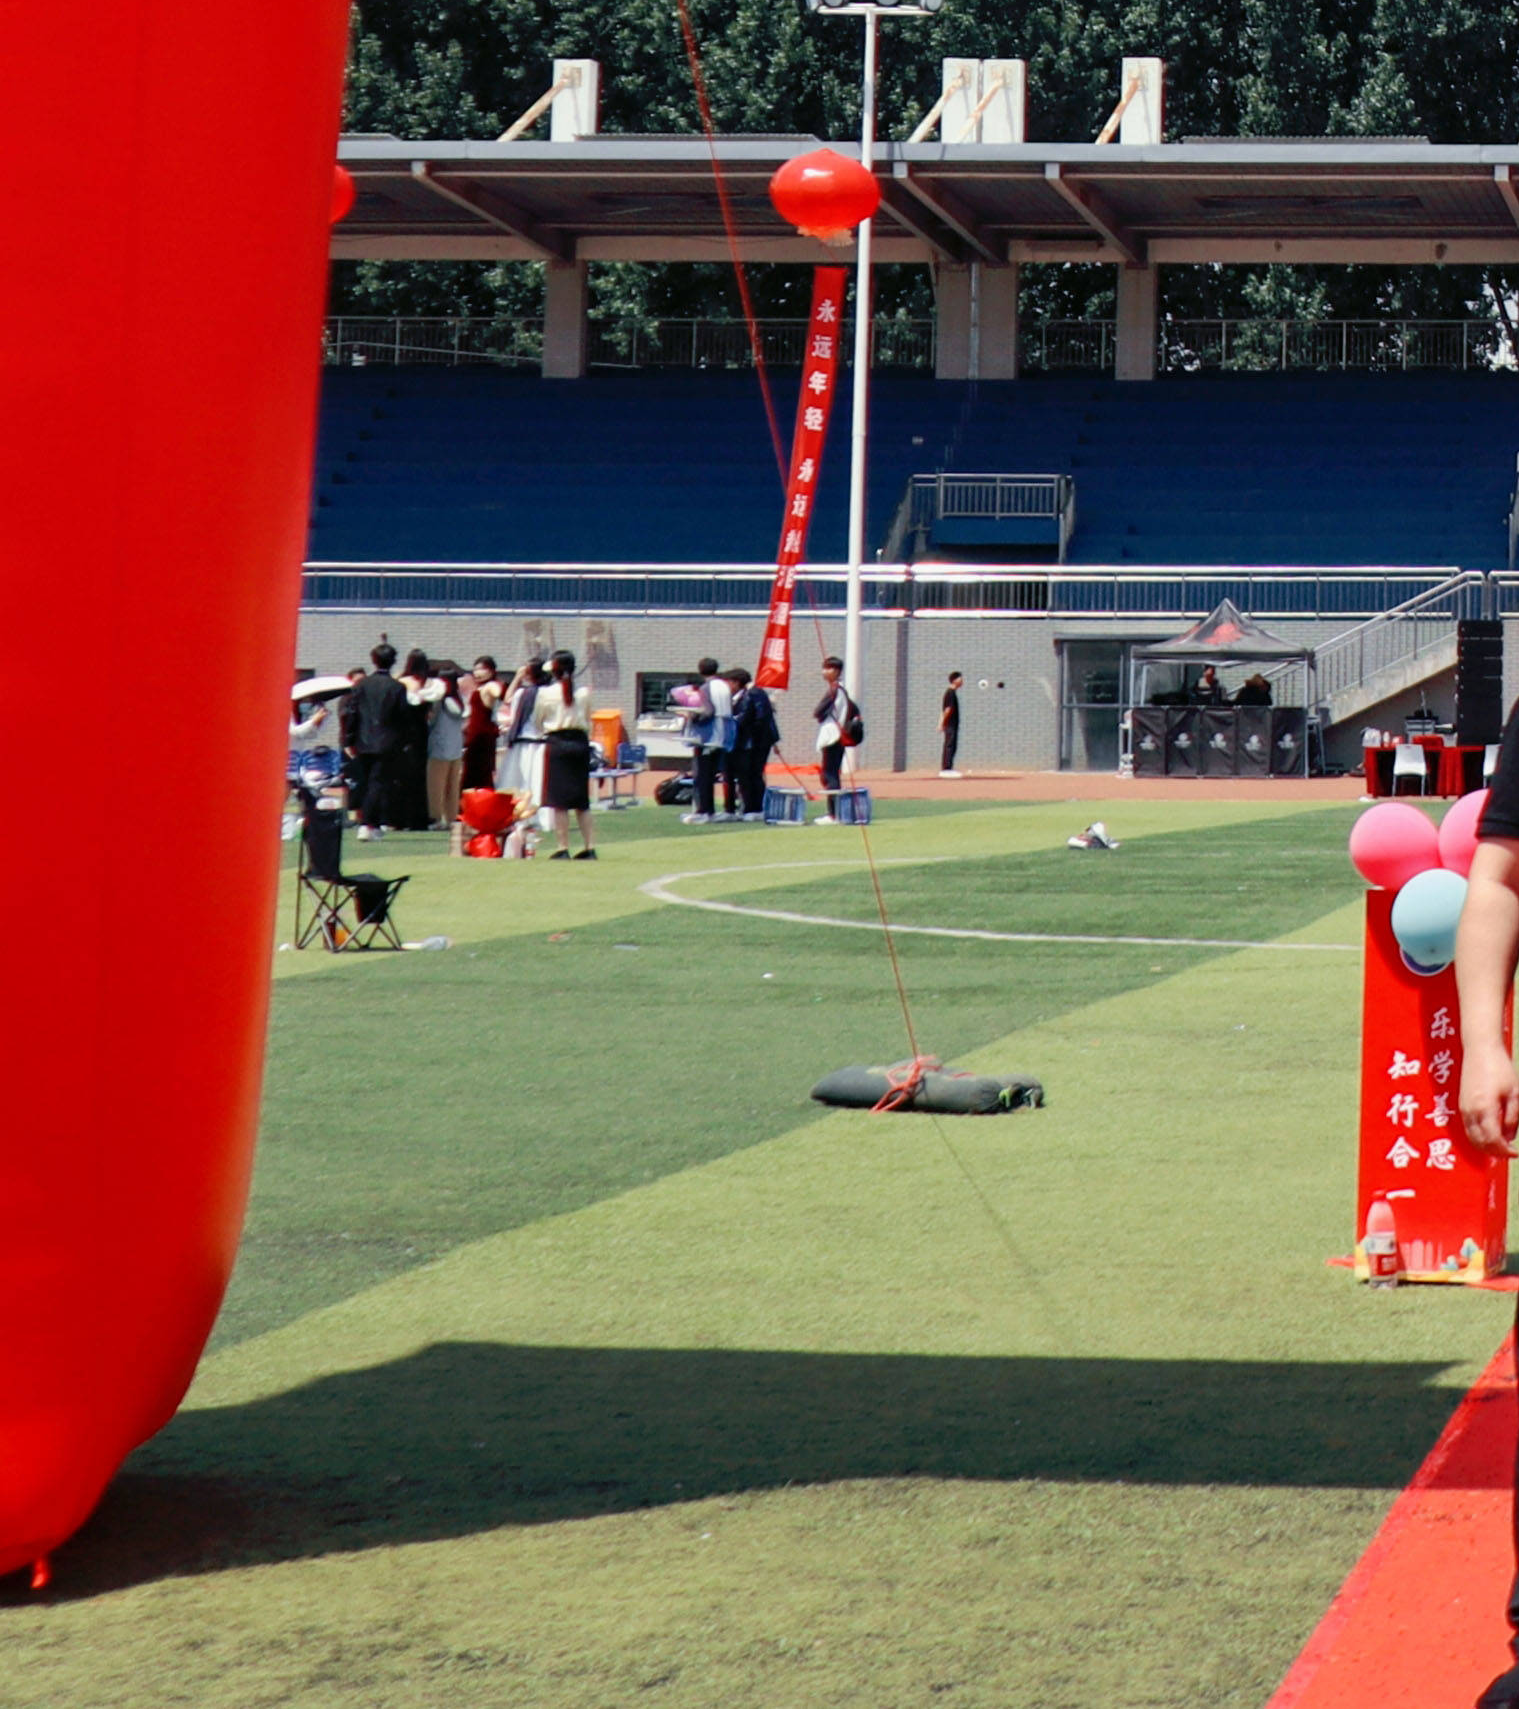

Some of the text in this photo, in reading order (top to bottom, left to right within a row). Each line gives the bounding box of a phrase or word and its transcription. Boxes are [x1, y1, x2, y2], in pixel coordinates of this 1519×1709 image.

[802, 298, 836, 432] 永远年轻
[1385, 1050, 1421, 1202] 知行合一
[1424, 1006, 1456, 1171] 乐学善思
